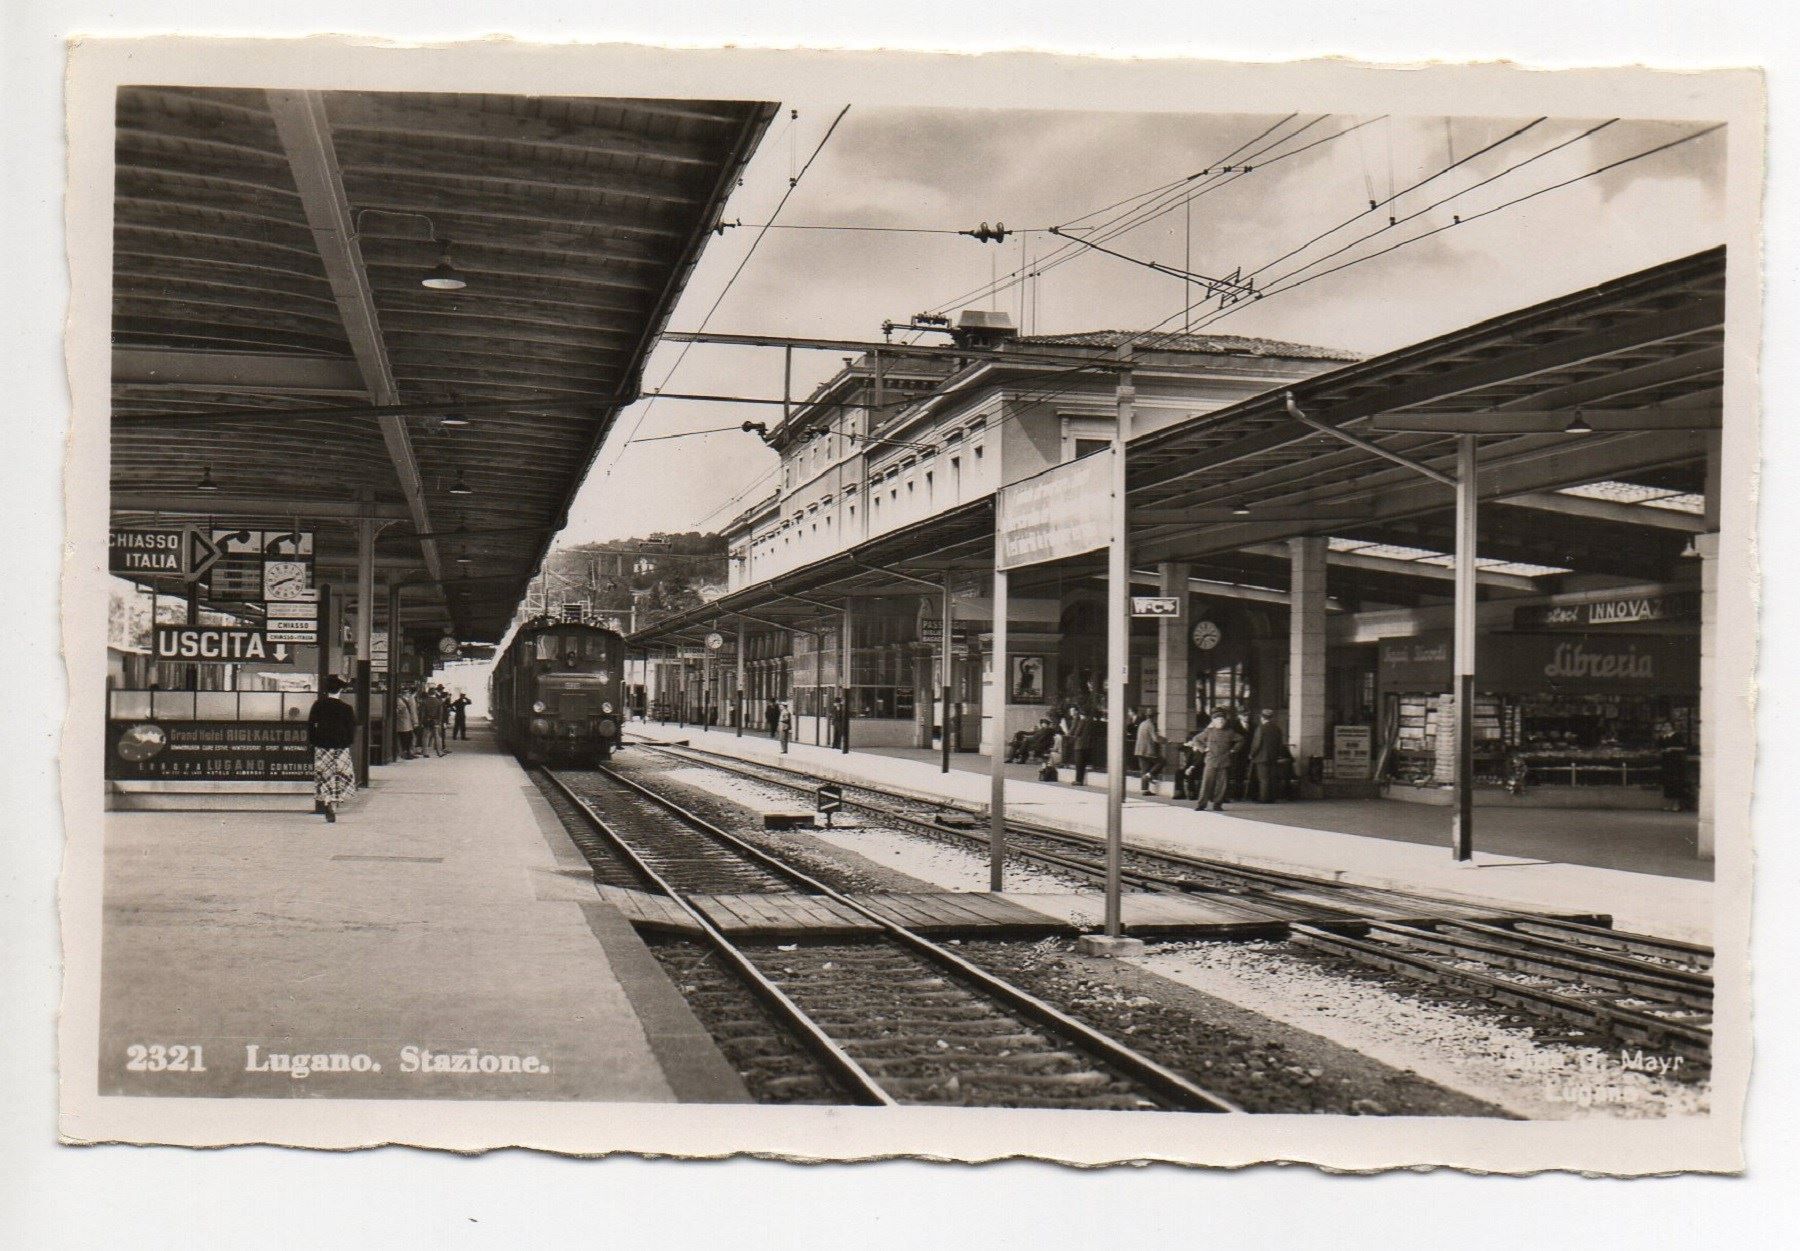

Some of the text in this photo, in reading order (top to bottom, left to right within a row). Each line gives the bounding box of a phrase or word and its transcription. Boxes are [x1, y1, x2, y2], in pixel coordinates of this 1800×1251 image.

[109, 533, 179, 549] CHIASSO
[126, 553, 178, 569] ITALIA
[159, 630, 266, 658] USCITA
[1544, 641, 1654, 678] Libreria
[207, 759, 265, 771] LUGANO
[270, 763, 315, 771] CONTINEN
